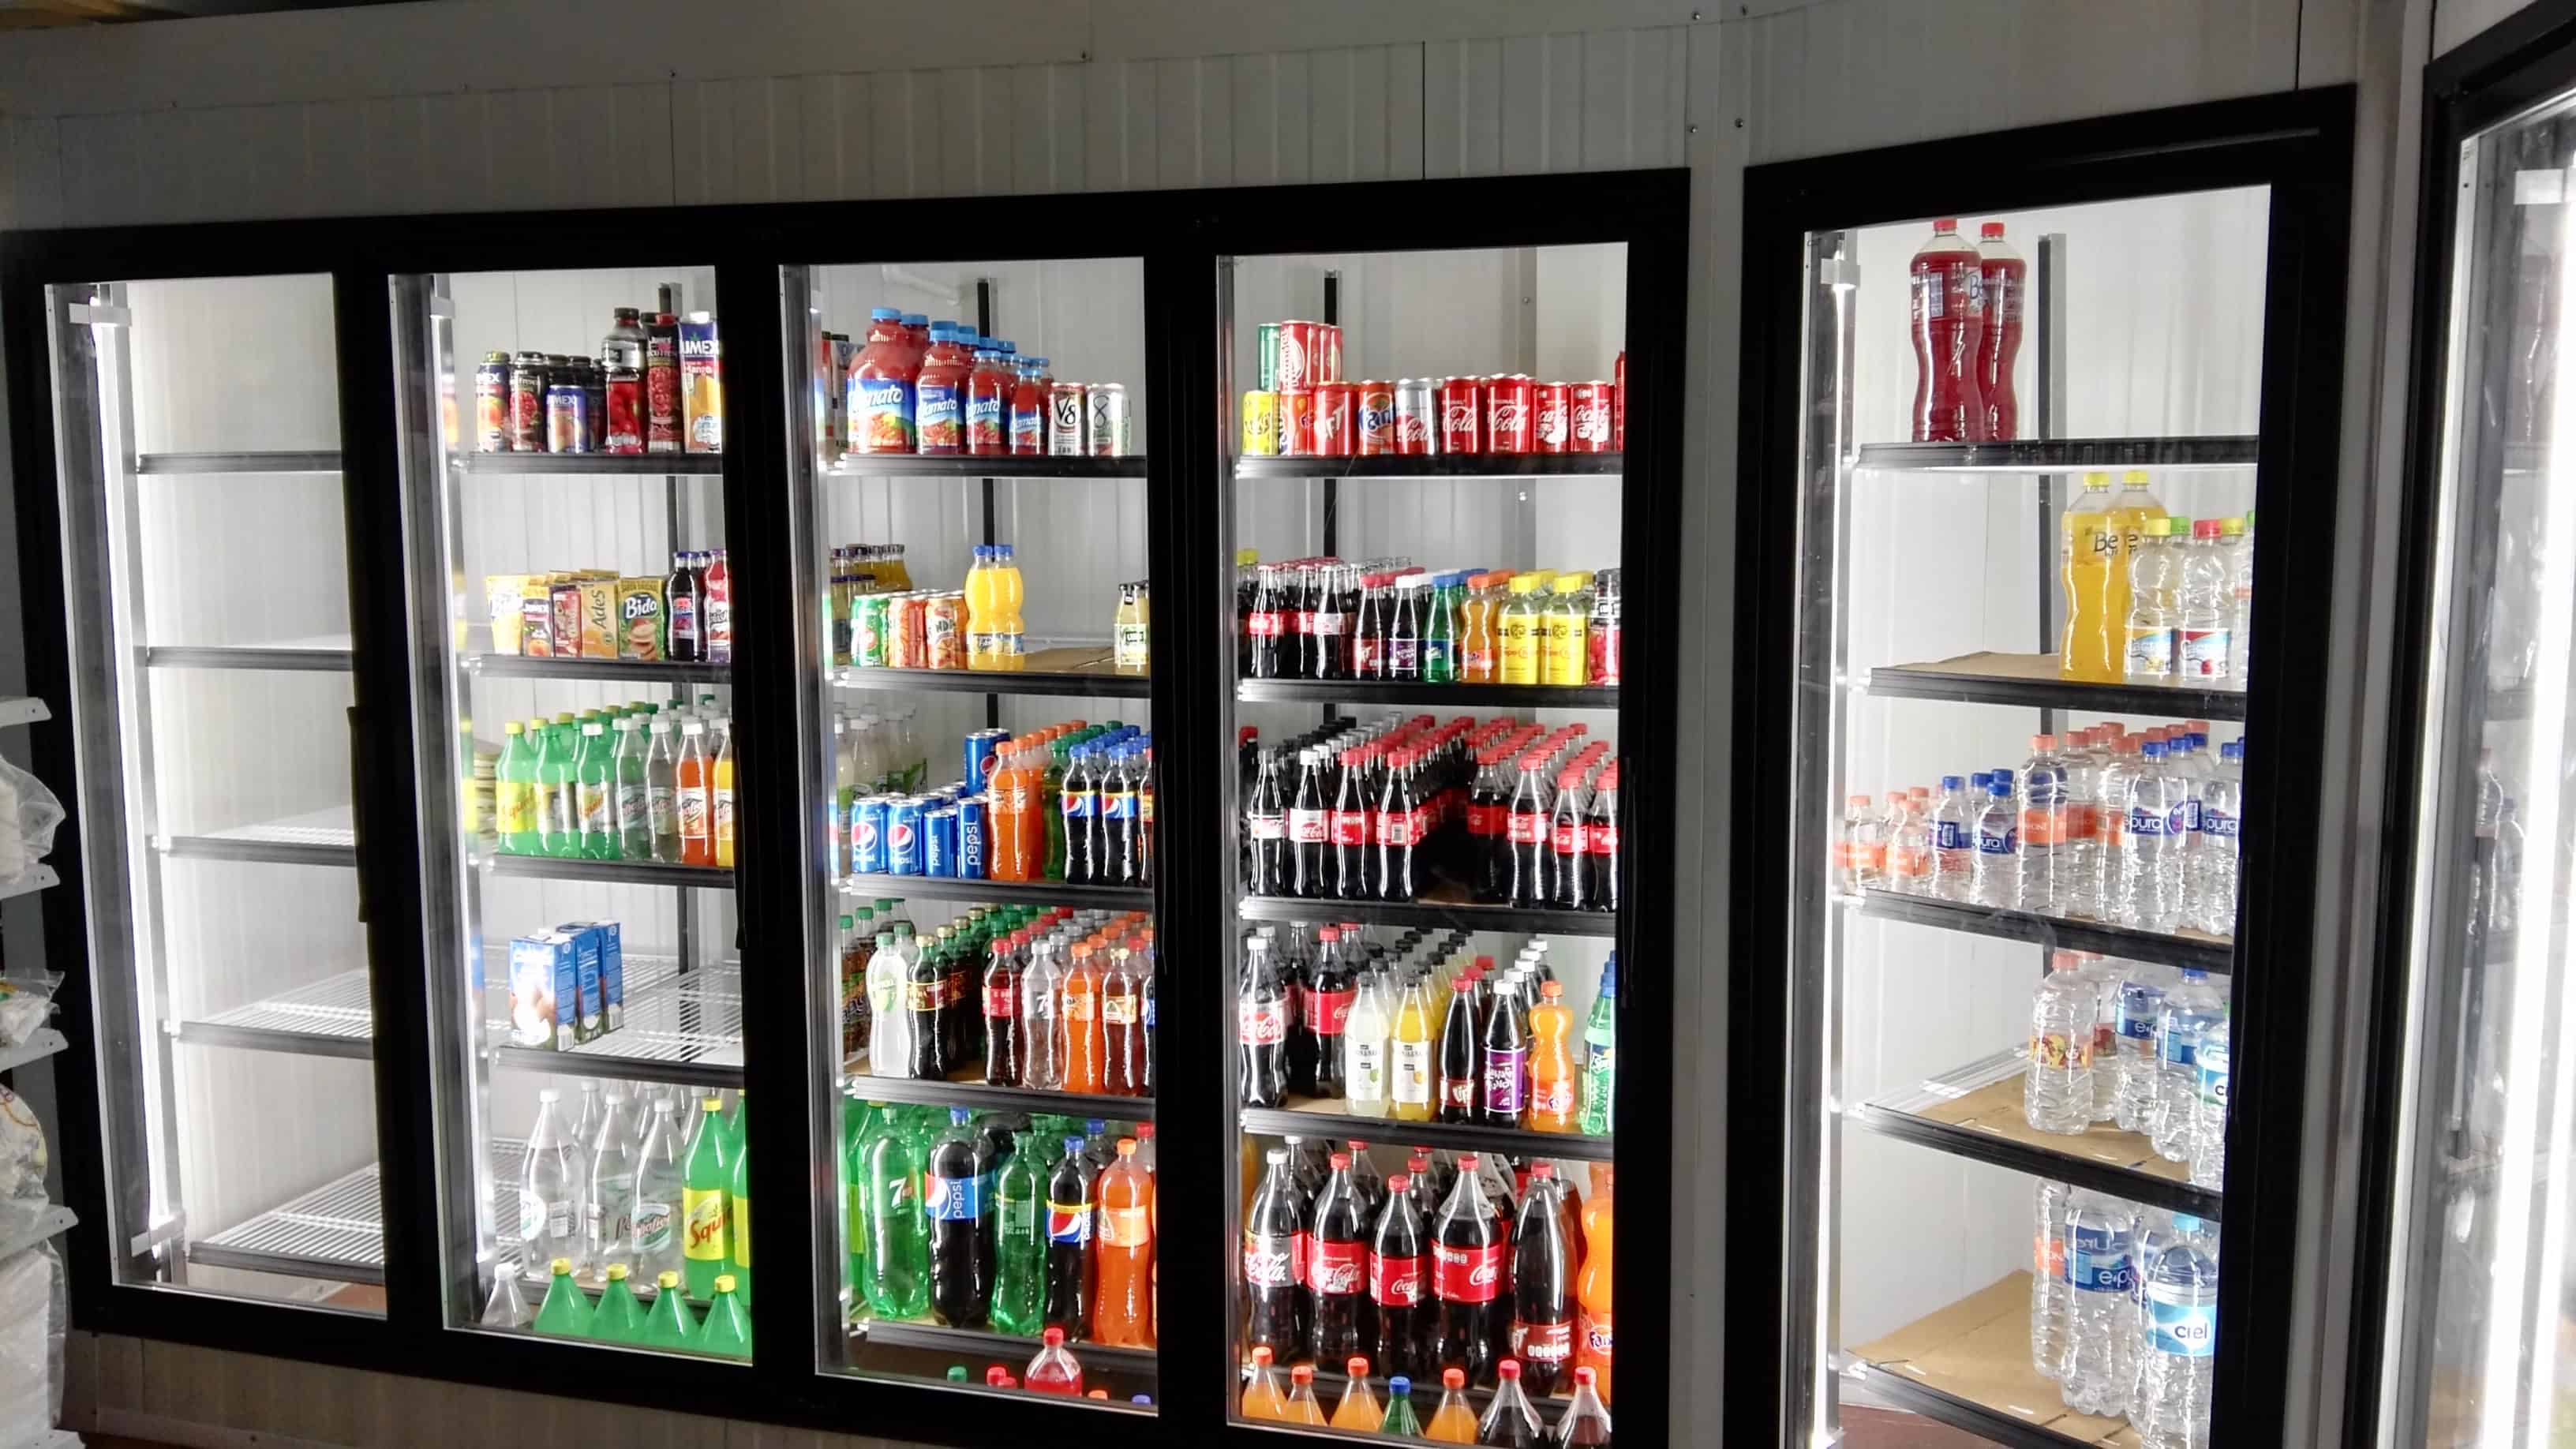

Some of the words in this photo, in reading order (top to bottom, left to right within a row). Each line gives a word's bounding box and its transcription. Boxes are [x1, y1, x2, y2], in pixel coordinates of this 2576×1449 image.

[1056, 396, 1076, 425] V8
[965, 821, 981, 866] pepsi
[950, 1179, 965, 1219] pepsi
[2174, 1323, 2207, 1339] ciel
